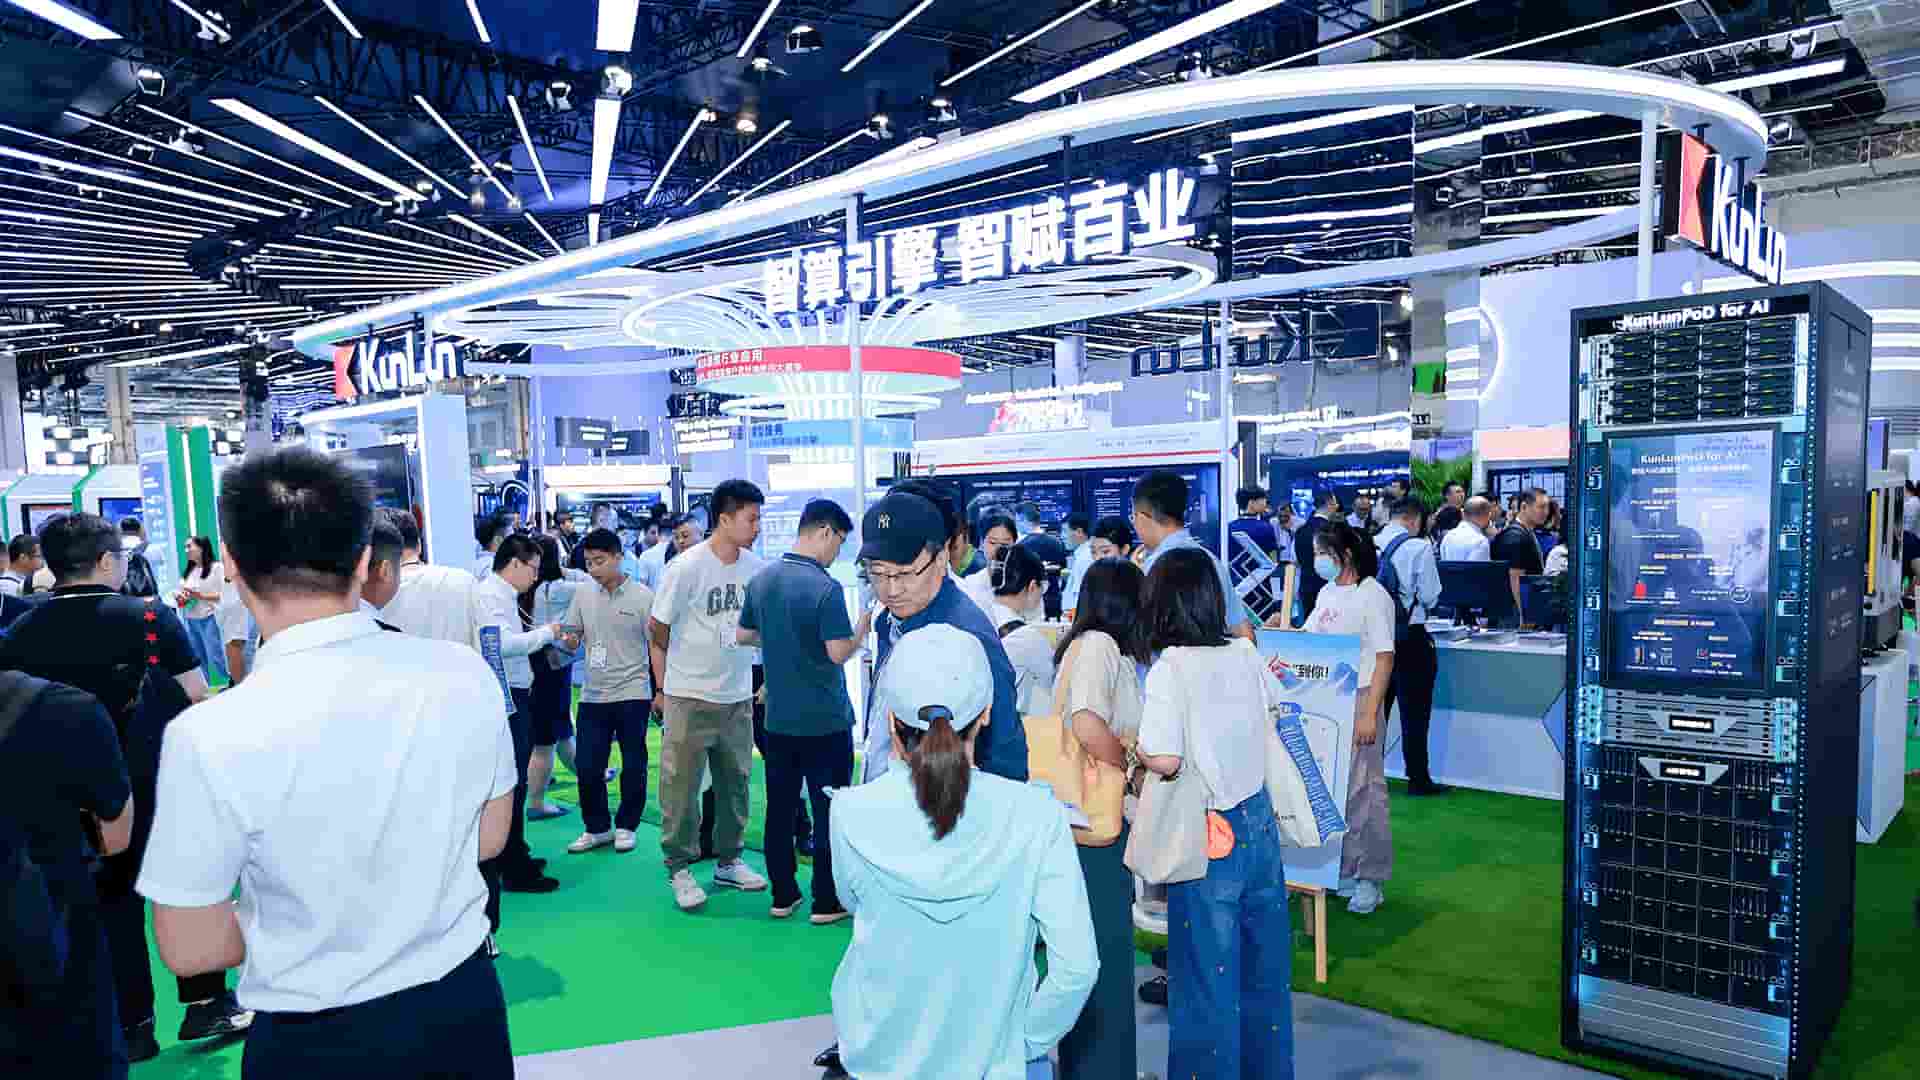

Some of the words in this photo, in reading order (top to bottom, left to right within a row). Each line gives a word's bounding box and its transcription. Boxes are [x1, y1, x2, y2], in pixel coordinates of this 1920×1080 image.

[764, 227, 938, 313] 智算引擎
[957, 167, 1197, 283] 智赋百业
[1720, 302, 1745, 319] for
[1750, 299, 1769, 314] AI
[707, 583, 746, 616] GA
